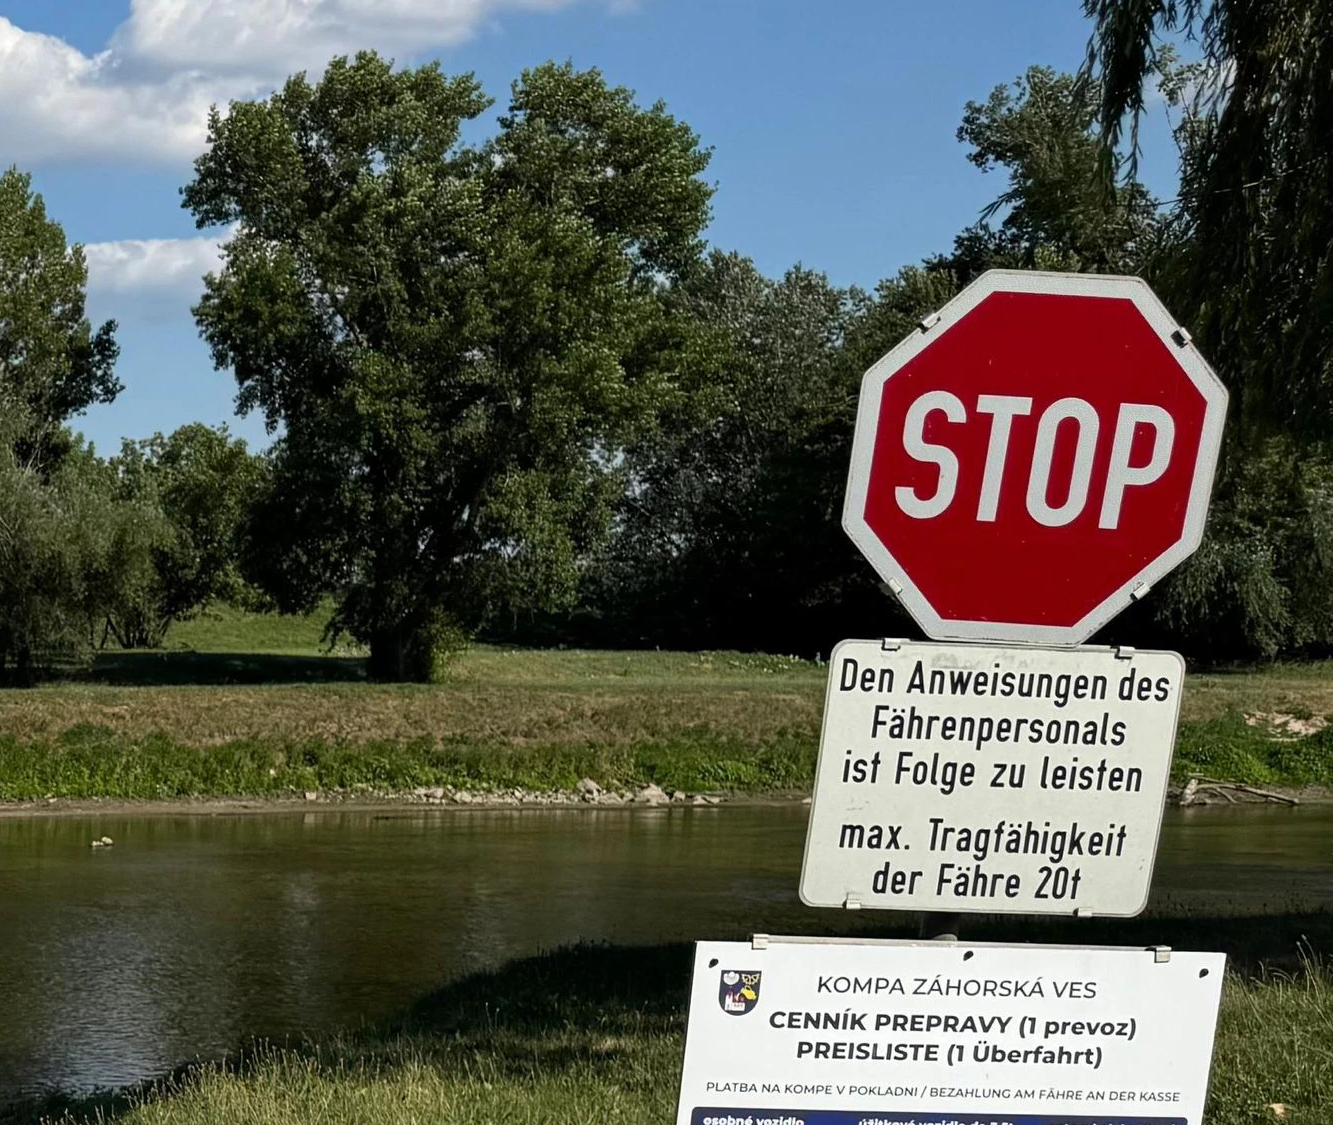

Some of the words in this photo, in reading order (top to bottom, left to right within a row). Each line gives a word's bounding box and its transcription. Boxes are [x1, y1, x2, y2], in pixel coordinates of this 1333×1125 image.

[895, 390, 1175, 530] STOP
[839, 658, 895, 694] Den
[906, 661, 1109, 707] Anweisungen
[1118, 668, 1170, 702] des
[871, 705, 1126, 751] Fährenpersonals
[843, 753, 881, 784] ist
[895, 752, 975, 795] Folge
[990, 761, 1025, 788] zu
[1040, 756, 1142, 793] leisten
[839, 824, 910, 851] max.
[928, 818, 1126, 863] Tragfähigkeit
[873, 861, 922, 896] der
[936, 864, 1021, 898] Fähre
[1034, 866, 1081, 900] 20t
[817, 976, 906, 995] KOMPA
[912, 975, 1044, 998] ZÁHORSKÁ
[1052, 981, 1097, 999] VES
[769, 1010, 867, 1032] CENNÍK
[875, 1014, 1012, 1034] PREPRAVY
[1018, 1015, 1036, 1038] (1
[1044, 1017, 1136, 1040] prevoz)
[796, 1041, 940, 1062] PREISLISTE
[946, 1044, 965, 1066] (1
[972, 1042, 1102, 1069] Überfahrt)
[706, 1082, 757, 1093] PLATBA
[761, 1084, 780, 1094] NA
[784, 1084, 833, 1095] KOMPE
[835, 1085, 845, 1095] V
[848, 1085, 918, 1097] POKLADNI
[920, 1085, 927, 1098] /
[930, 1087, 1010, 1099] BEZAHLUNG
[1013, 1089, 1034, 1099] AM
[1038, 1087, 1082, 1100] FÄHRE
[1085, 1090, 1105, 1100] AN
[1109, 1090, 1136, 1101] DER
[1139, 1091, 1181, 1102] KASSE
